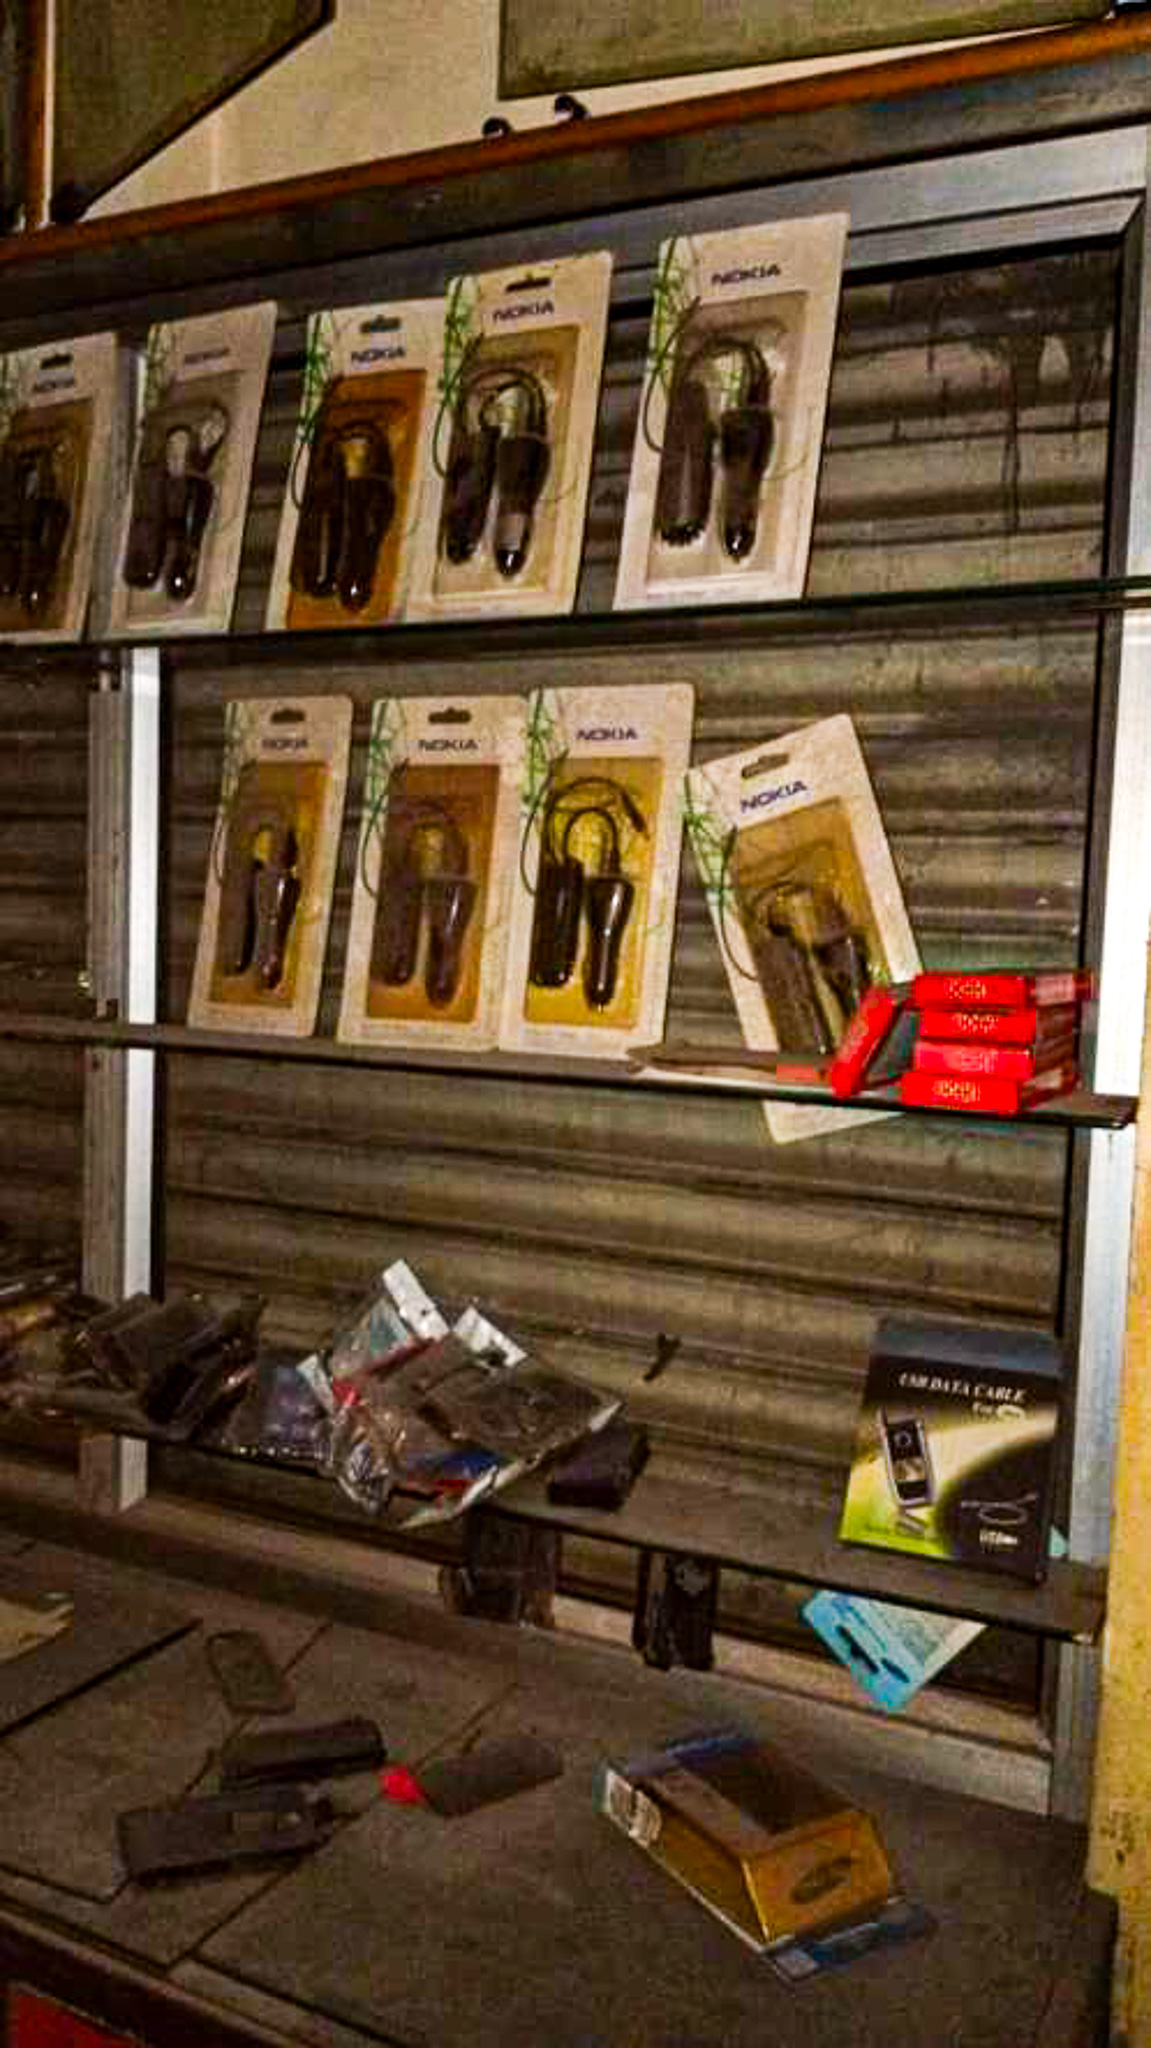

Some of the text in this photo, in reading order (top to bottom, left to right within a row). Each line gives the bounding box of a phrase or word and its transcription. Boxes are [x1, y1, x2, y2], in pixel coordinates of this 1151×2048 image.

[711, 264, 781, 286] NOKIA
[491, 299, 555, 323] NOKIA
[350, 346, 405, 364] NOKIA
[417, 737, 478, 753] NOKIA
[575, 726, 639, 743] NOKIA
[740, 780, 808, 813] NOKIA
[928, 1378, 971, 1397] DATA
[972, 1384, 1026, 1403] CABLE
